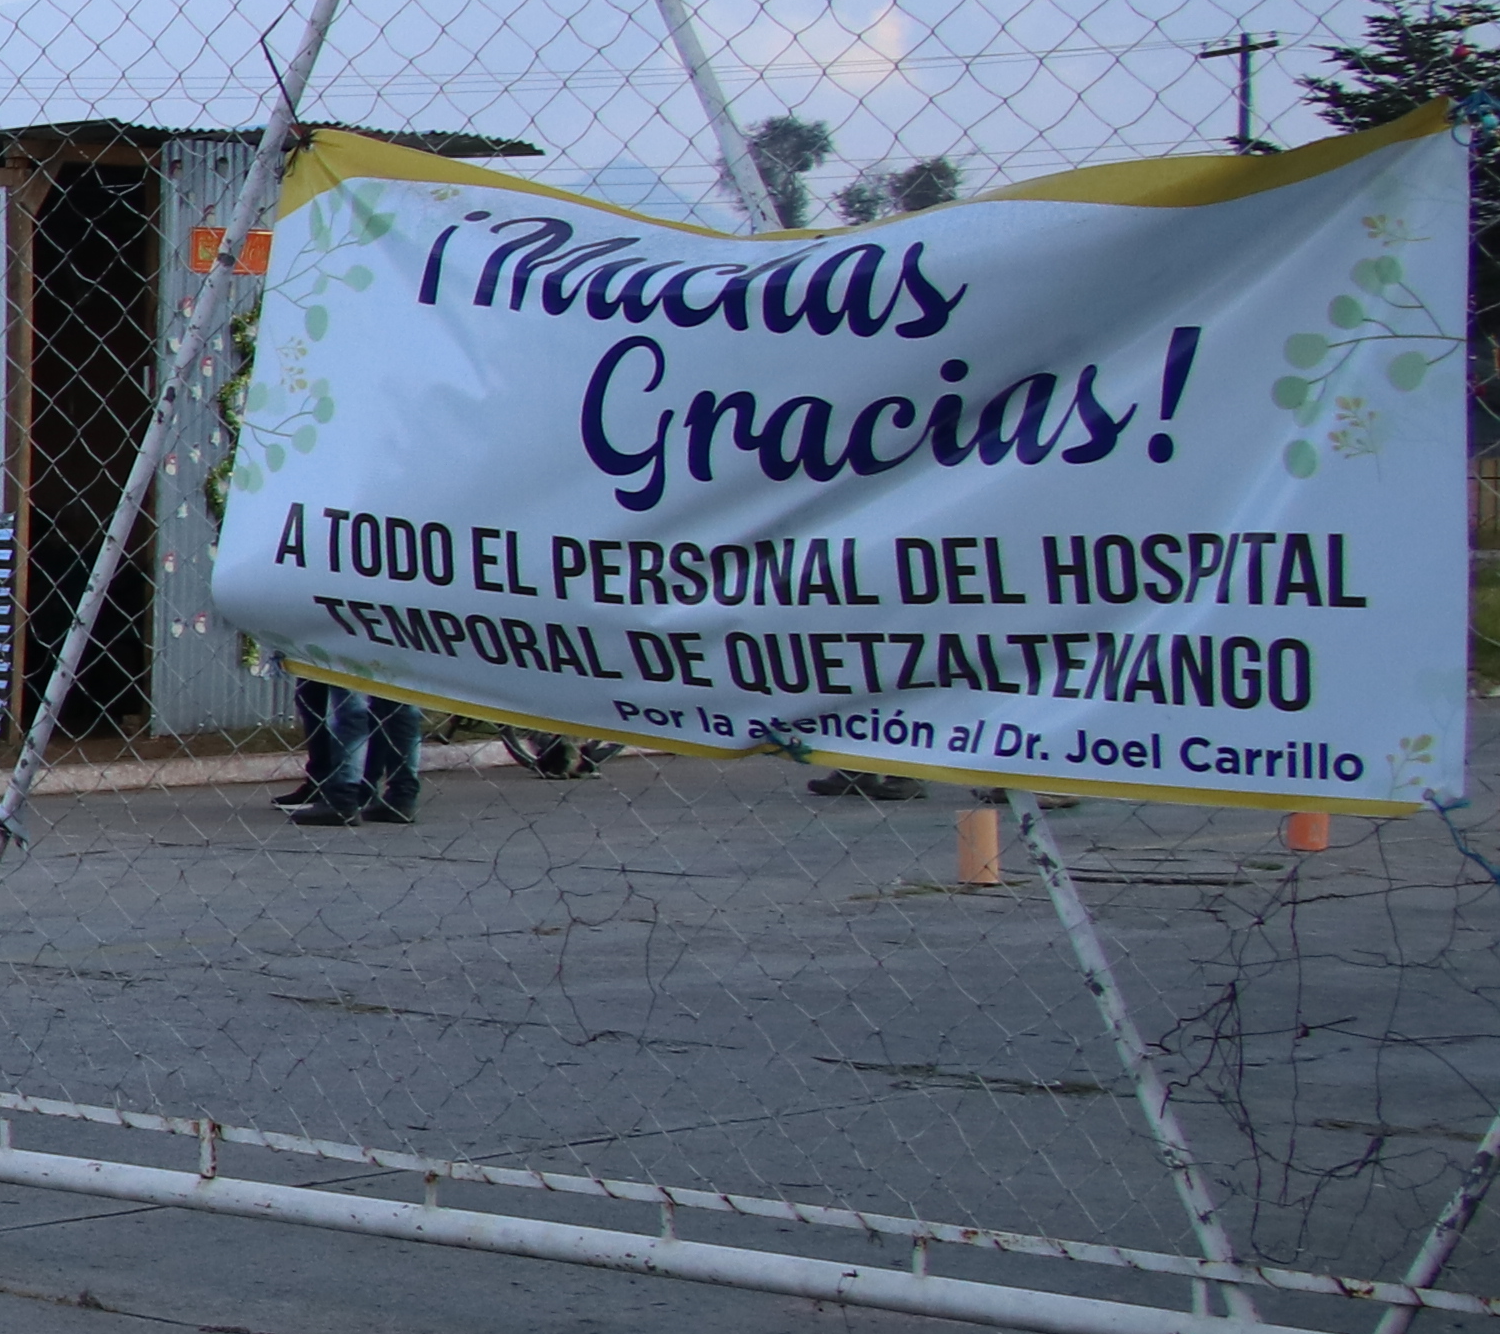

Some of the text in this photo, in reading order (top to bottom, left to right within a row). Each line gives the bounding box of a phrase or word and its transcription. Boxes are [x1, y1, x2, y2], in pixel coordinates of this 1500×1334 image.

[581, 326, 1201, 511] Gracias!
[275, 503, 1367, 608] A TODO EL PERSONAL DEL HOSPITAL
[314, 595, 1311, 715] TEMPORAL DE QUETZALTENANGO
[613, 700, 1364, 781] Por la atención al Dr. Joel Carrillo
